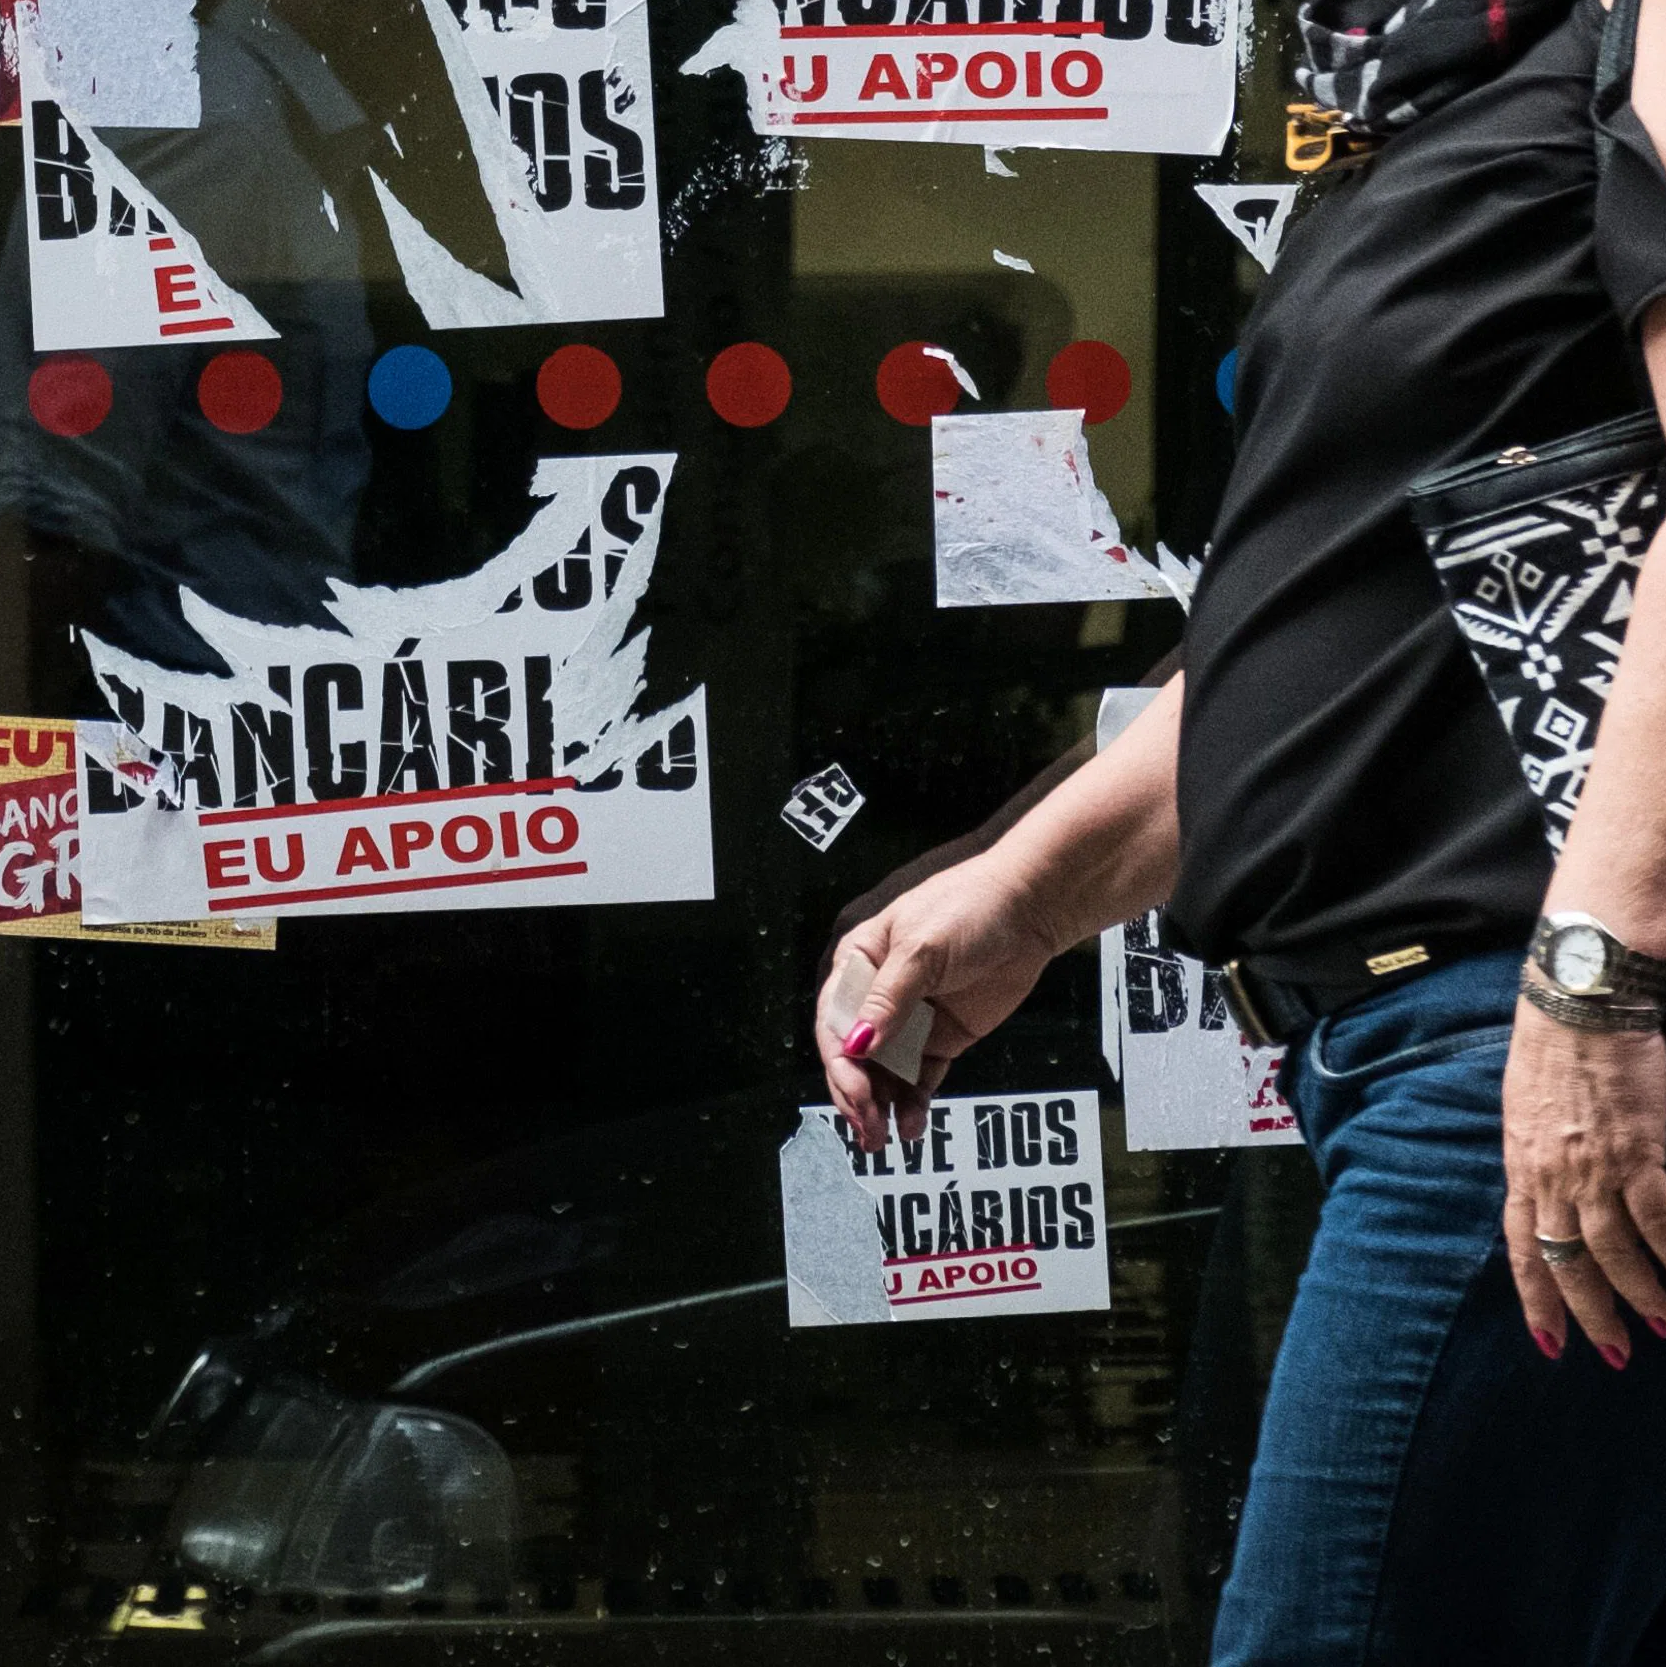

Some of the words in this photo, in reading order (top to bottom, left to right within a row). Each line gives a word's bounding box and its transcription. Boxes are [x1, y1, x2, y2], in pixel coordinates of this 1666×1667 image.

[857, 50, 1104, 102] APOIO
[202, 832, 306, 890] EU
[335, 806, 580, 875] APOIO
[974, 1098, 1078, 1170] DOS
[917, 1257, 1038, 1293] APOIO
